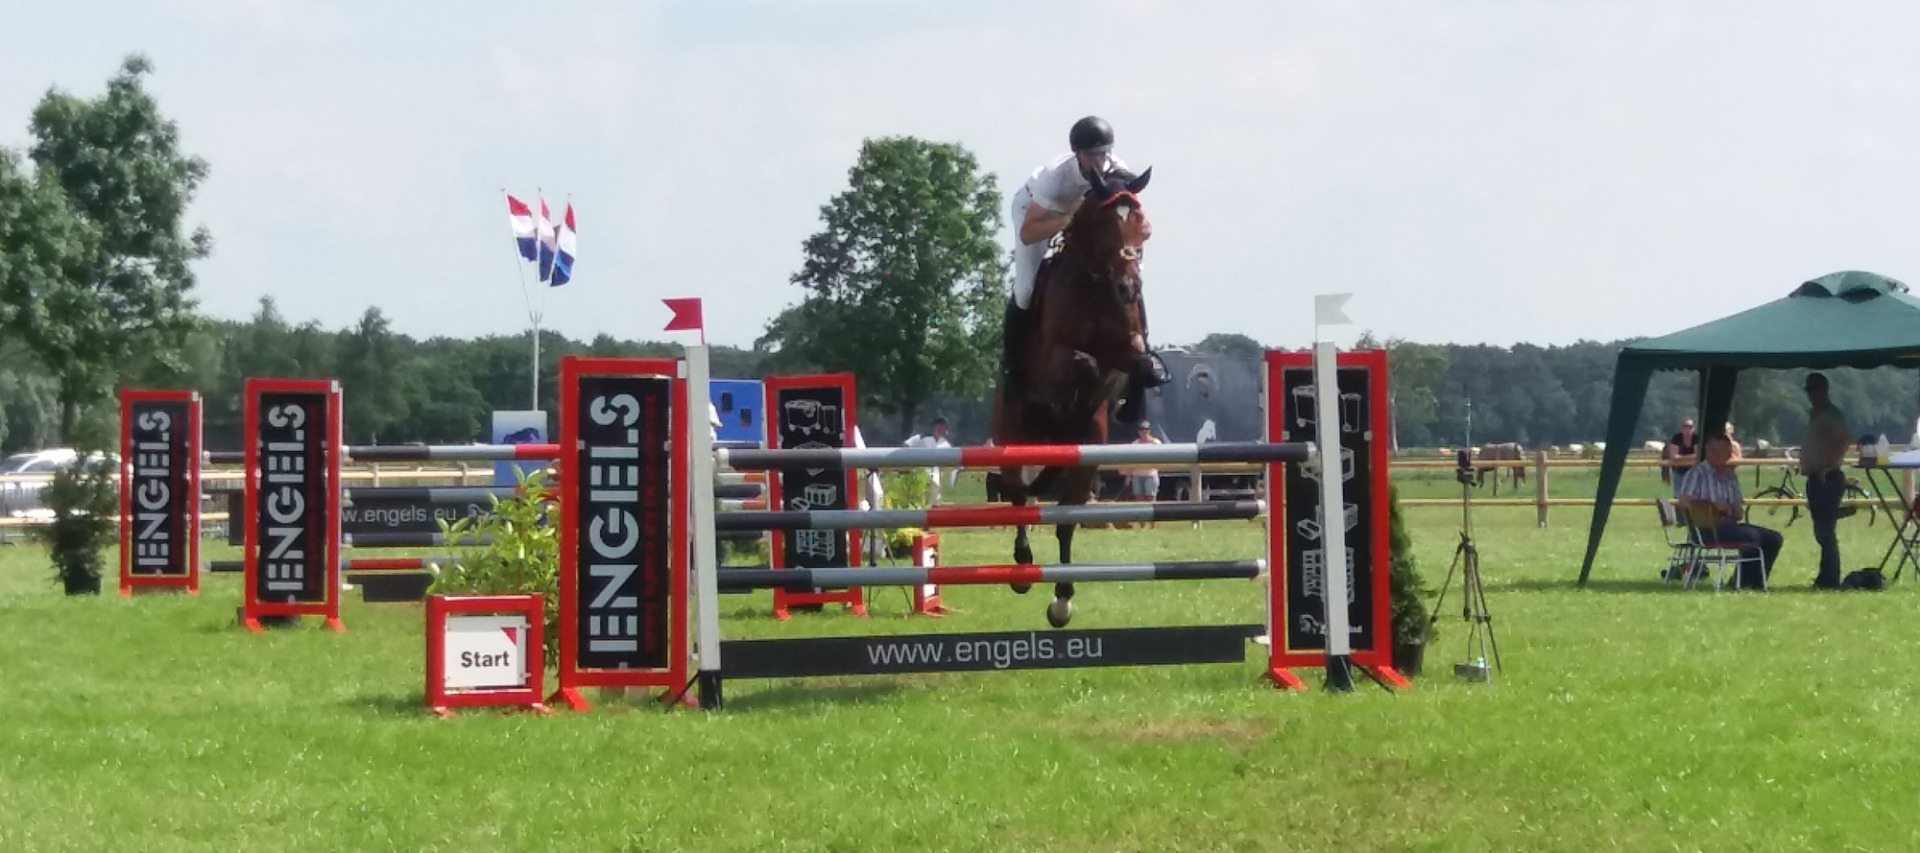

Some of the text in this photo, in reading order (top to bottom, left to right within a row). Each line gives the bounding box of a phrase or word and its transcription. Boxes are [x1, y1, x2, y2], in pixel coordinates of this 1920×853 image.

[138, 411, 171, 566] ENGELS
[267, 403, 305, 591] ENGELS
[589, 393, 640, 652] ENGELS
[460, 650, 509, 669] Start
[868, 631, 1103, 668] www.engels.eu
